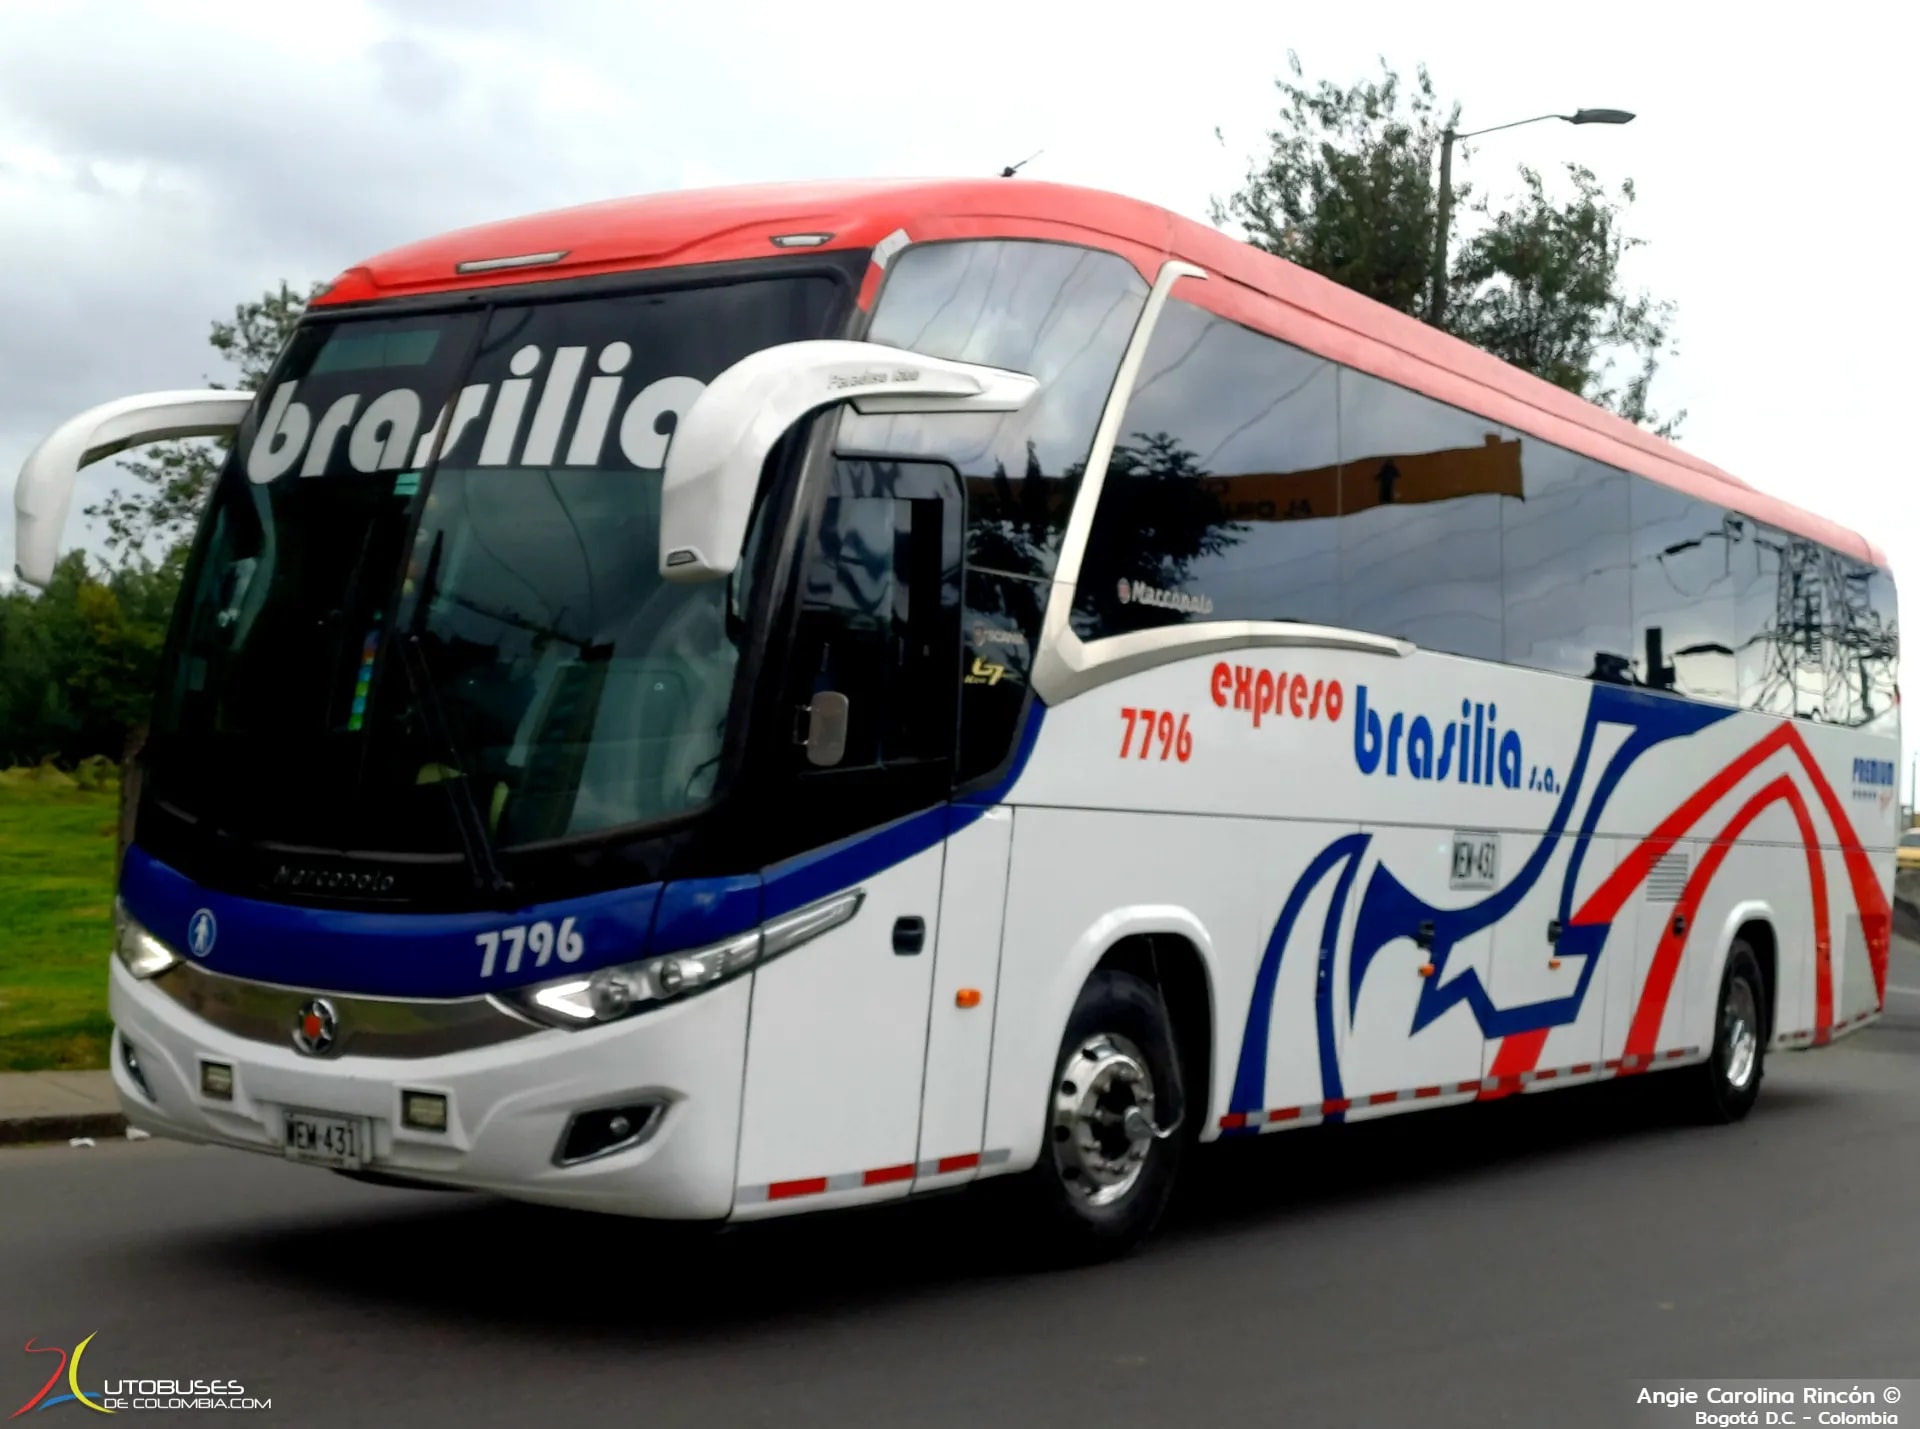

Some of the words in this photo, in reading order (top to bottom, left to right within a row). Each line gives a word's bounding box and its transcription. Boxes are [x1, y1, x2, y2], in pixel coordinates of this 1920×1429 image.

[247, 341, 709, 485] brasilia
[1210, 661, 1344, 728] expreso
[1118, 707, 1193, 763] 7796
[1353, 684, 1523, 790] brasilia
[475, 916, 584, 978] 7796
[286, 1120, 356, 1157] WEM-431
